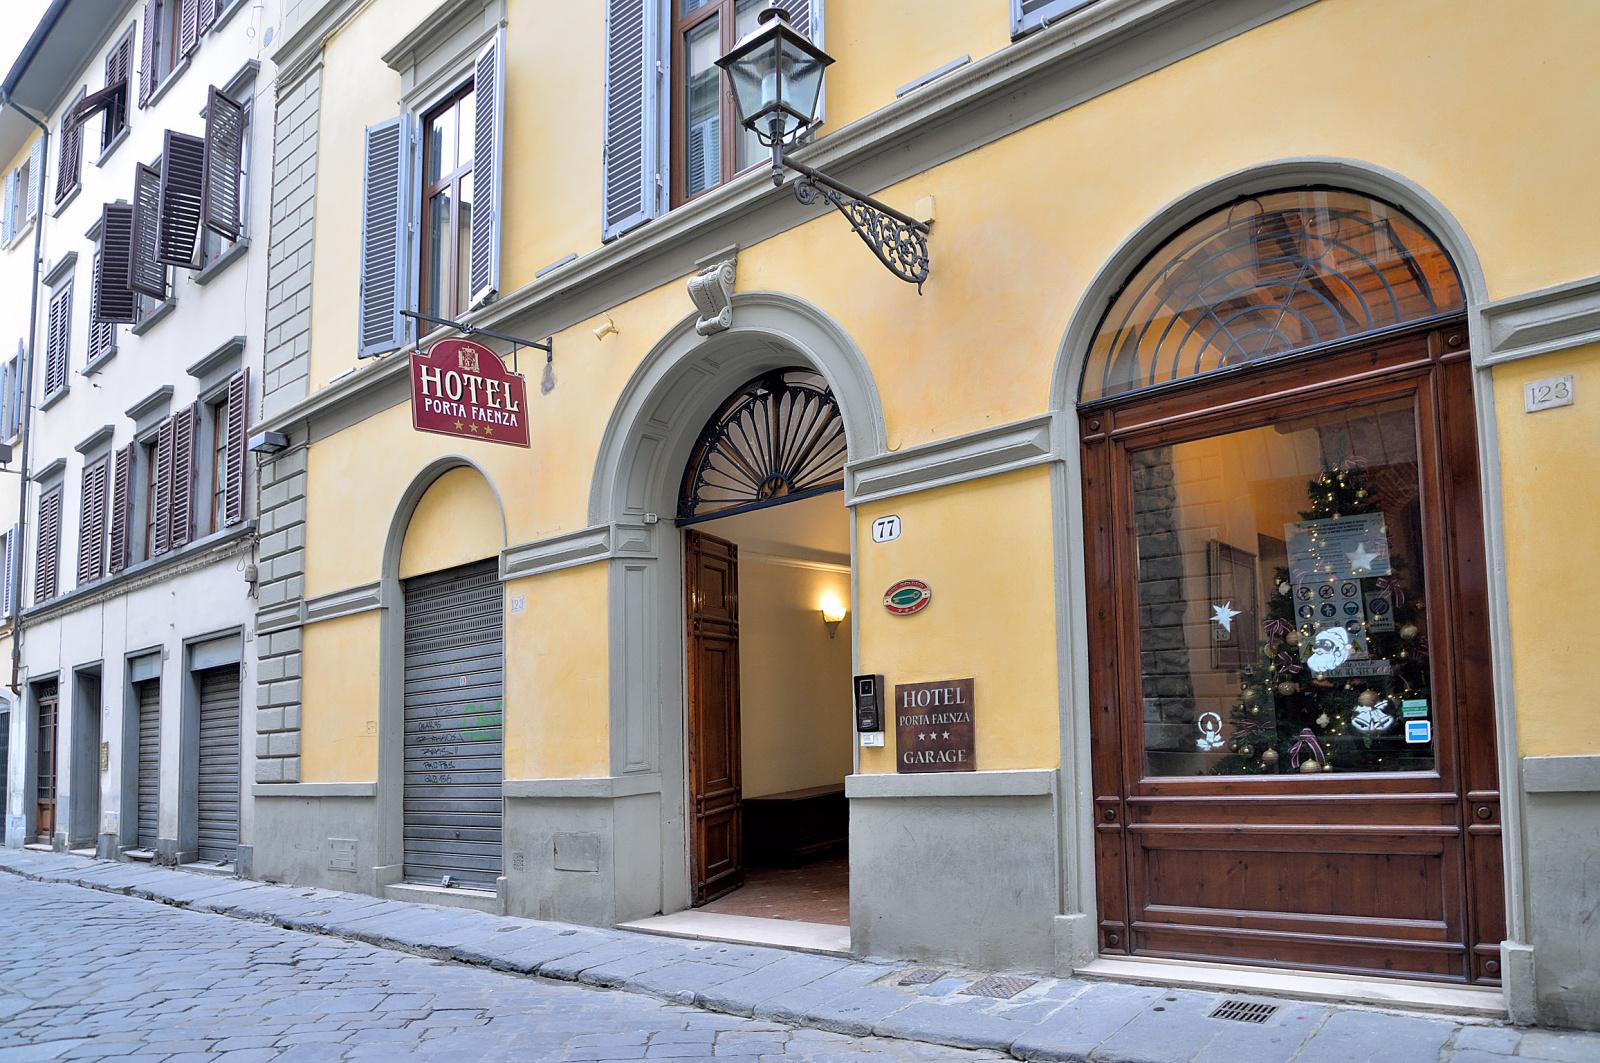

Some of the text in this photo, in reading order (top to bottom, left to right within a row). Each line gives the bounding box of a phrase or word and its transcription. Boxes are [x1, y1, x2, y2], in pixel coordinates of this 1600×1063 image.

[420, 364, 519, 412] HOTEL
[1532, 381, 1570, 405] 123
[424, 397, 518, 427] PORTA FAENZA
[877, 519, 895, 538] 77
[903, 687, 966, 708] HOTEL
[899, 712, 970, 726] PORTA FAENZA
[903, 749, 967, 764] GARAGE
